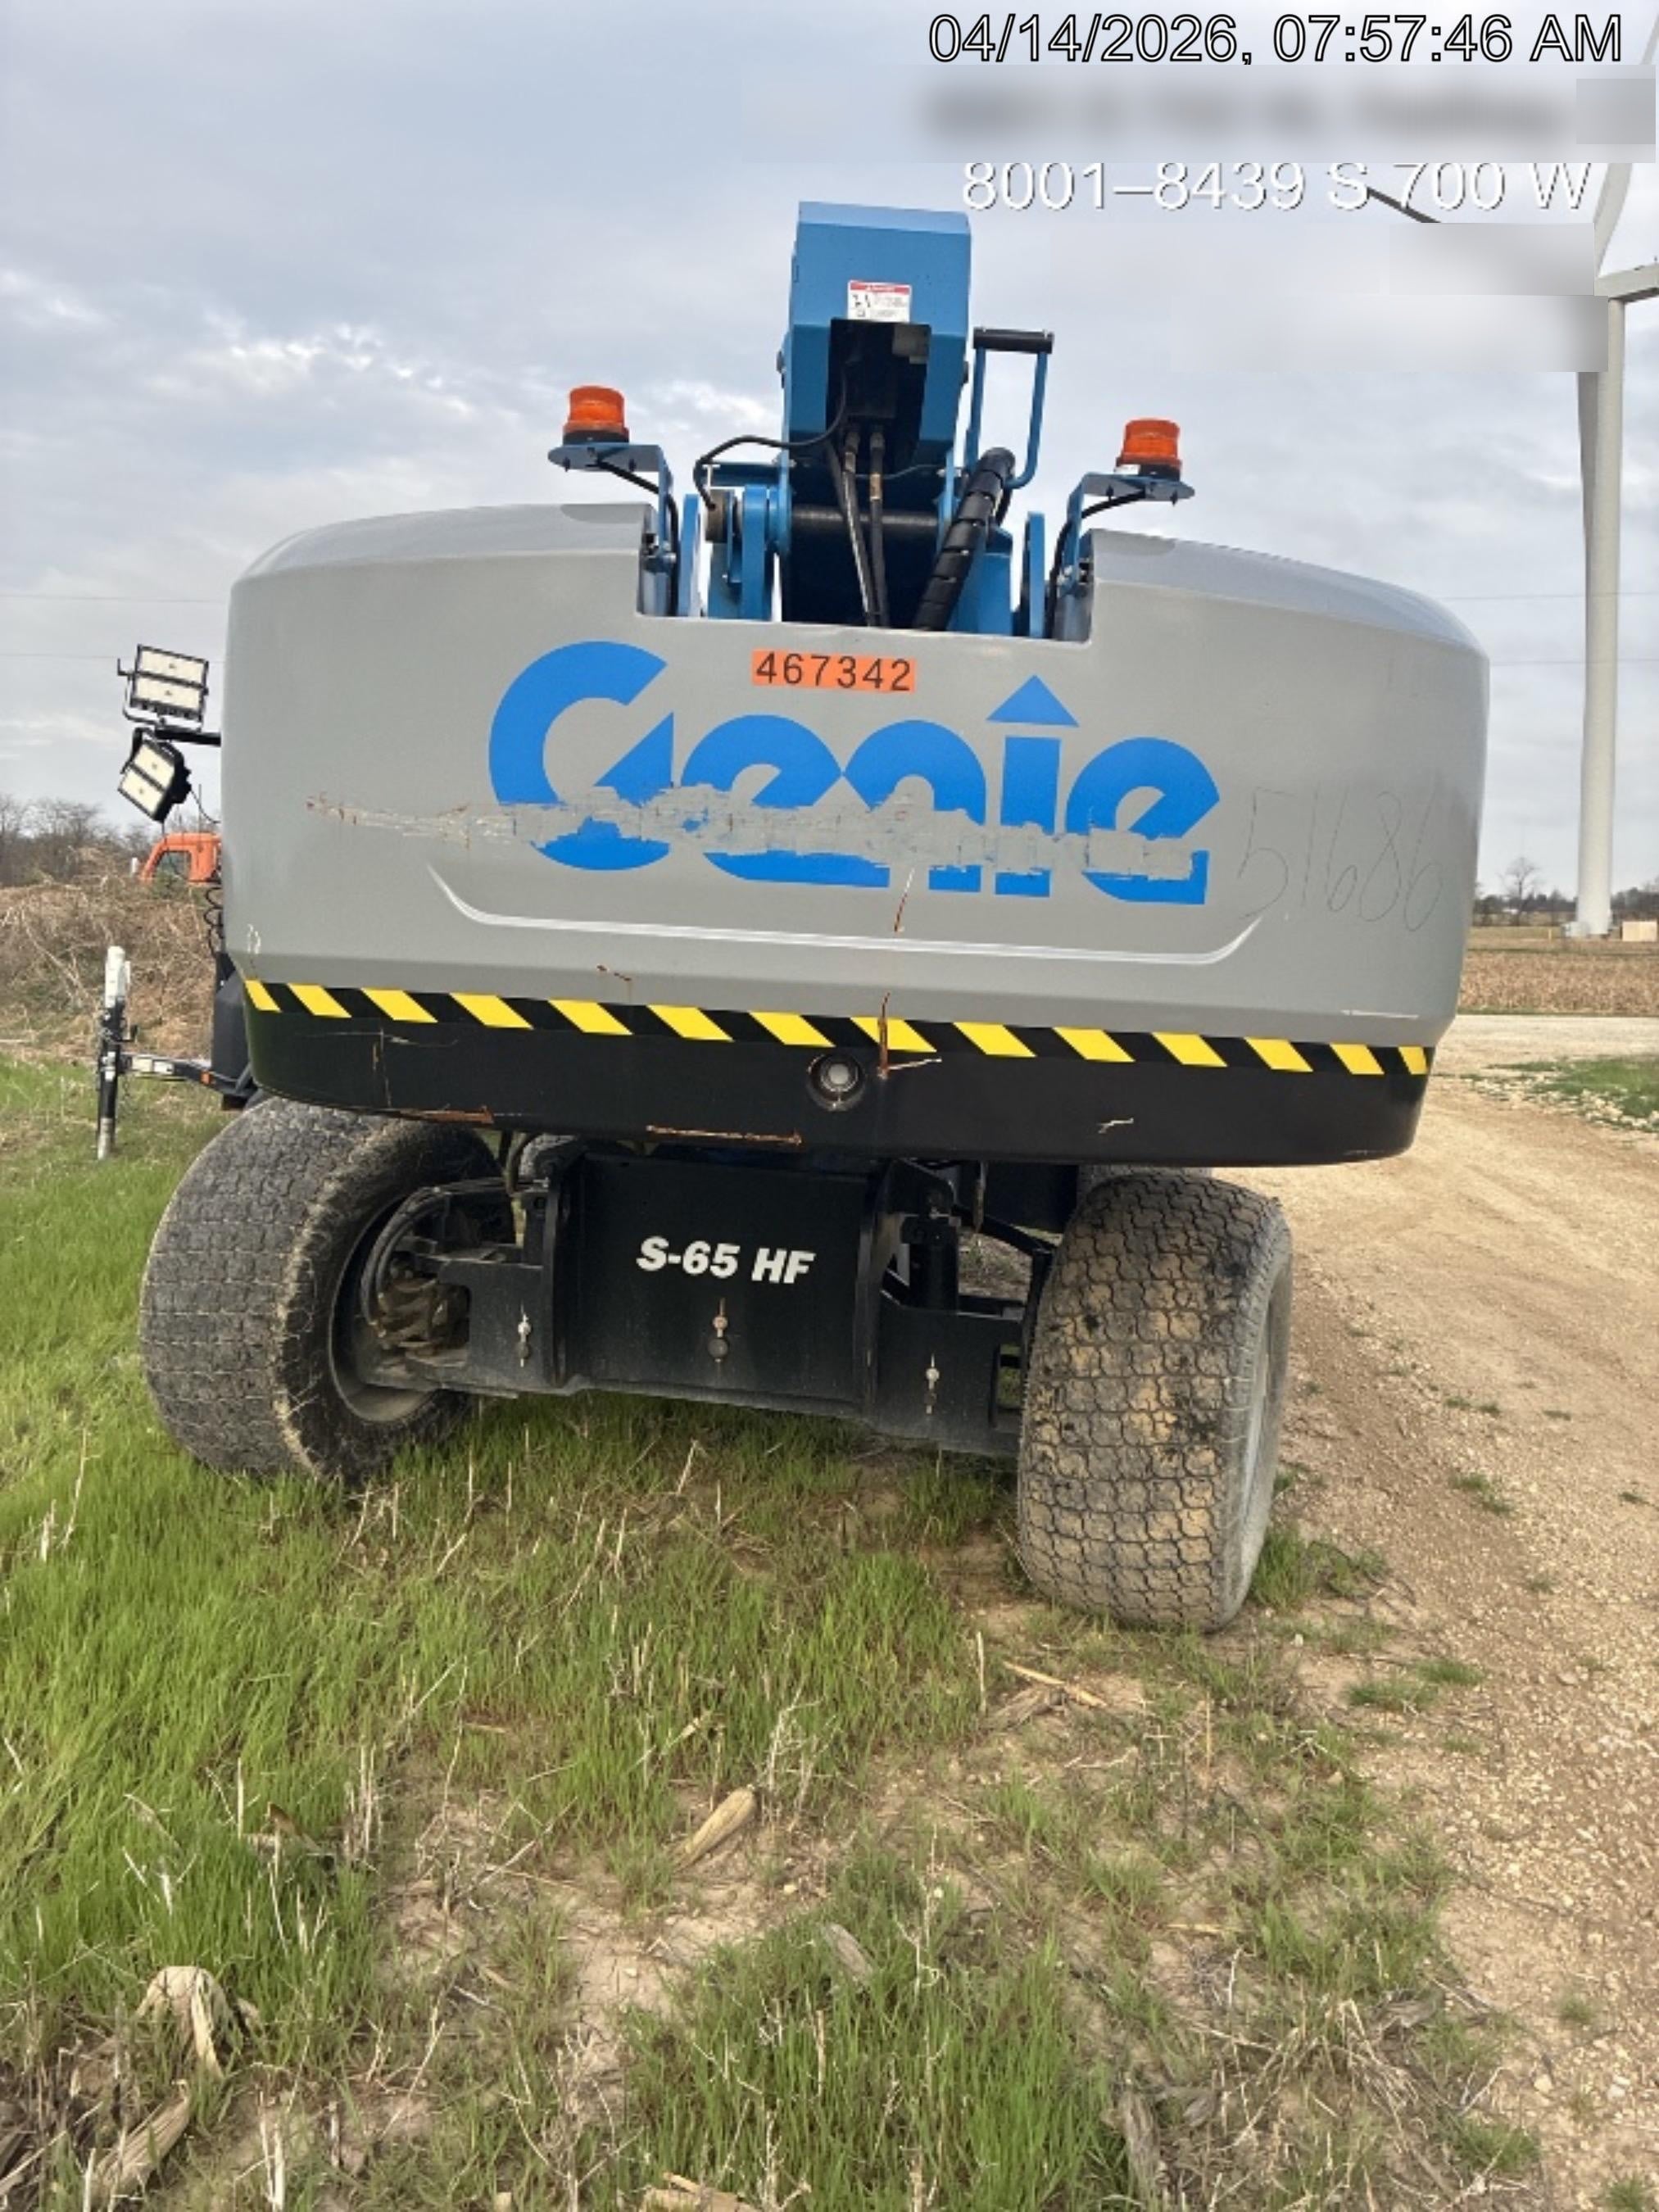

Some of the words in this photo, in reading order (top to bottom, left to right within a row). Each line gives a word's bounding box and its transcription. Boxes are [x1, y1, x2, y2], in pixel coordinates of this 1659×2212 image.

[755, 650, 911, 691] 467342
[488, 641, 1220, 905] Genie
[636, 1235, 741, 1279] S-65
[750, 1247, 817, 1285] HF
